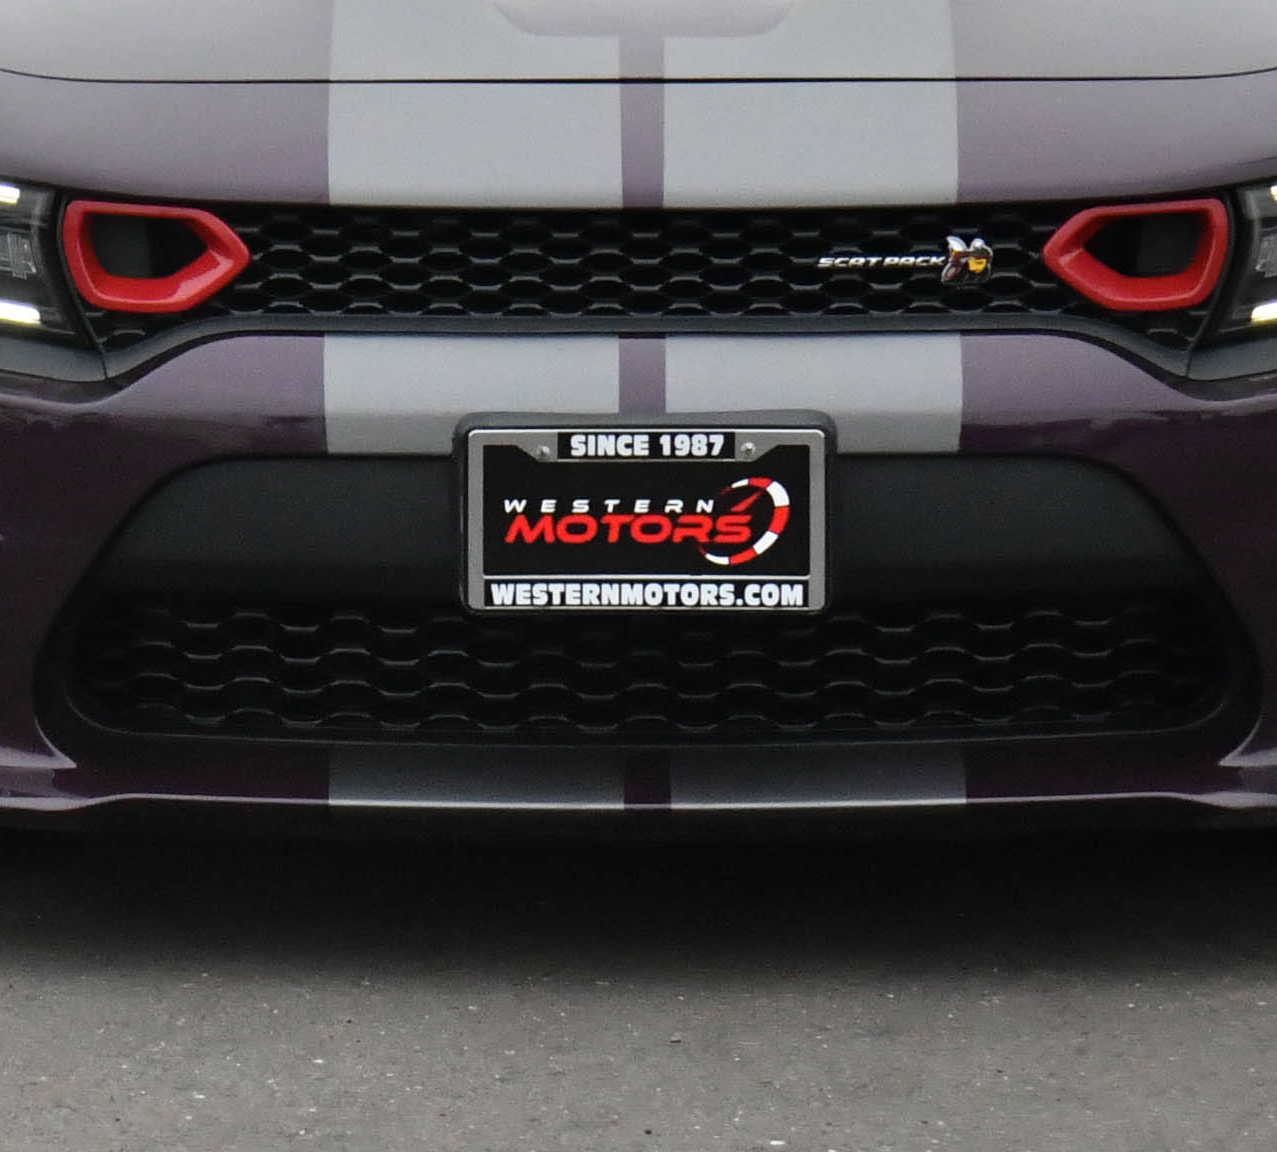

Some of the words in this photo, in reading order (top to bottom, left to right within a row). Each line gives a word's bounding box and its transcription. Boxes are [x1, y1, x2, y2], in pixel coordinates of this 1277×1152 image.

[570, 433, 651, 457] SINCE
[659, 433, 725, 457] 1987
[504, 498, 715, 514] WESTERN
[504, 512, 753, 545] MOTORS
[490, 582, 805, 608] WESTERNMOTORS.COM
